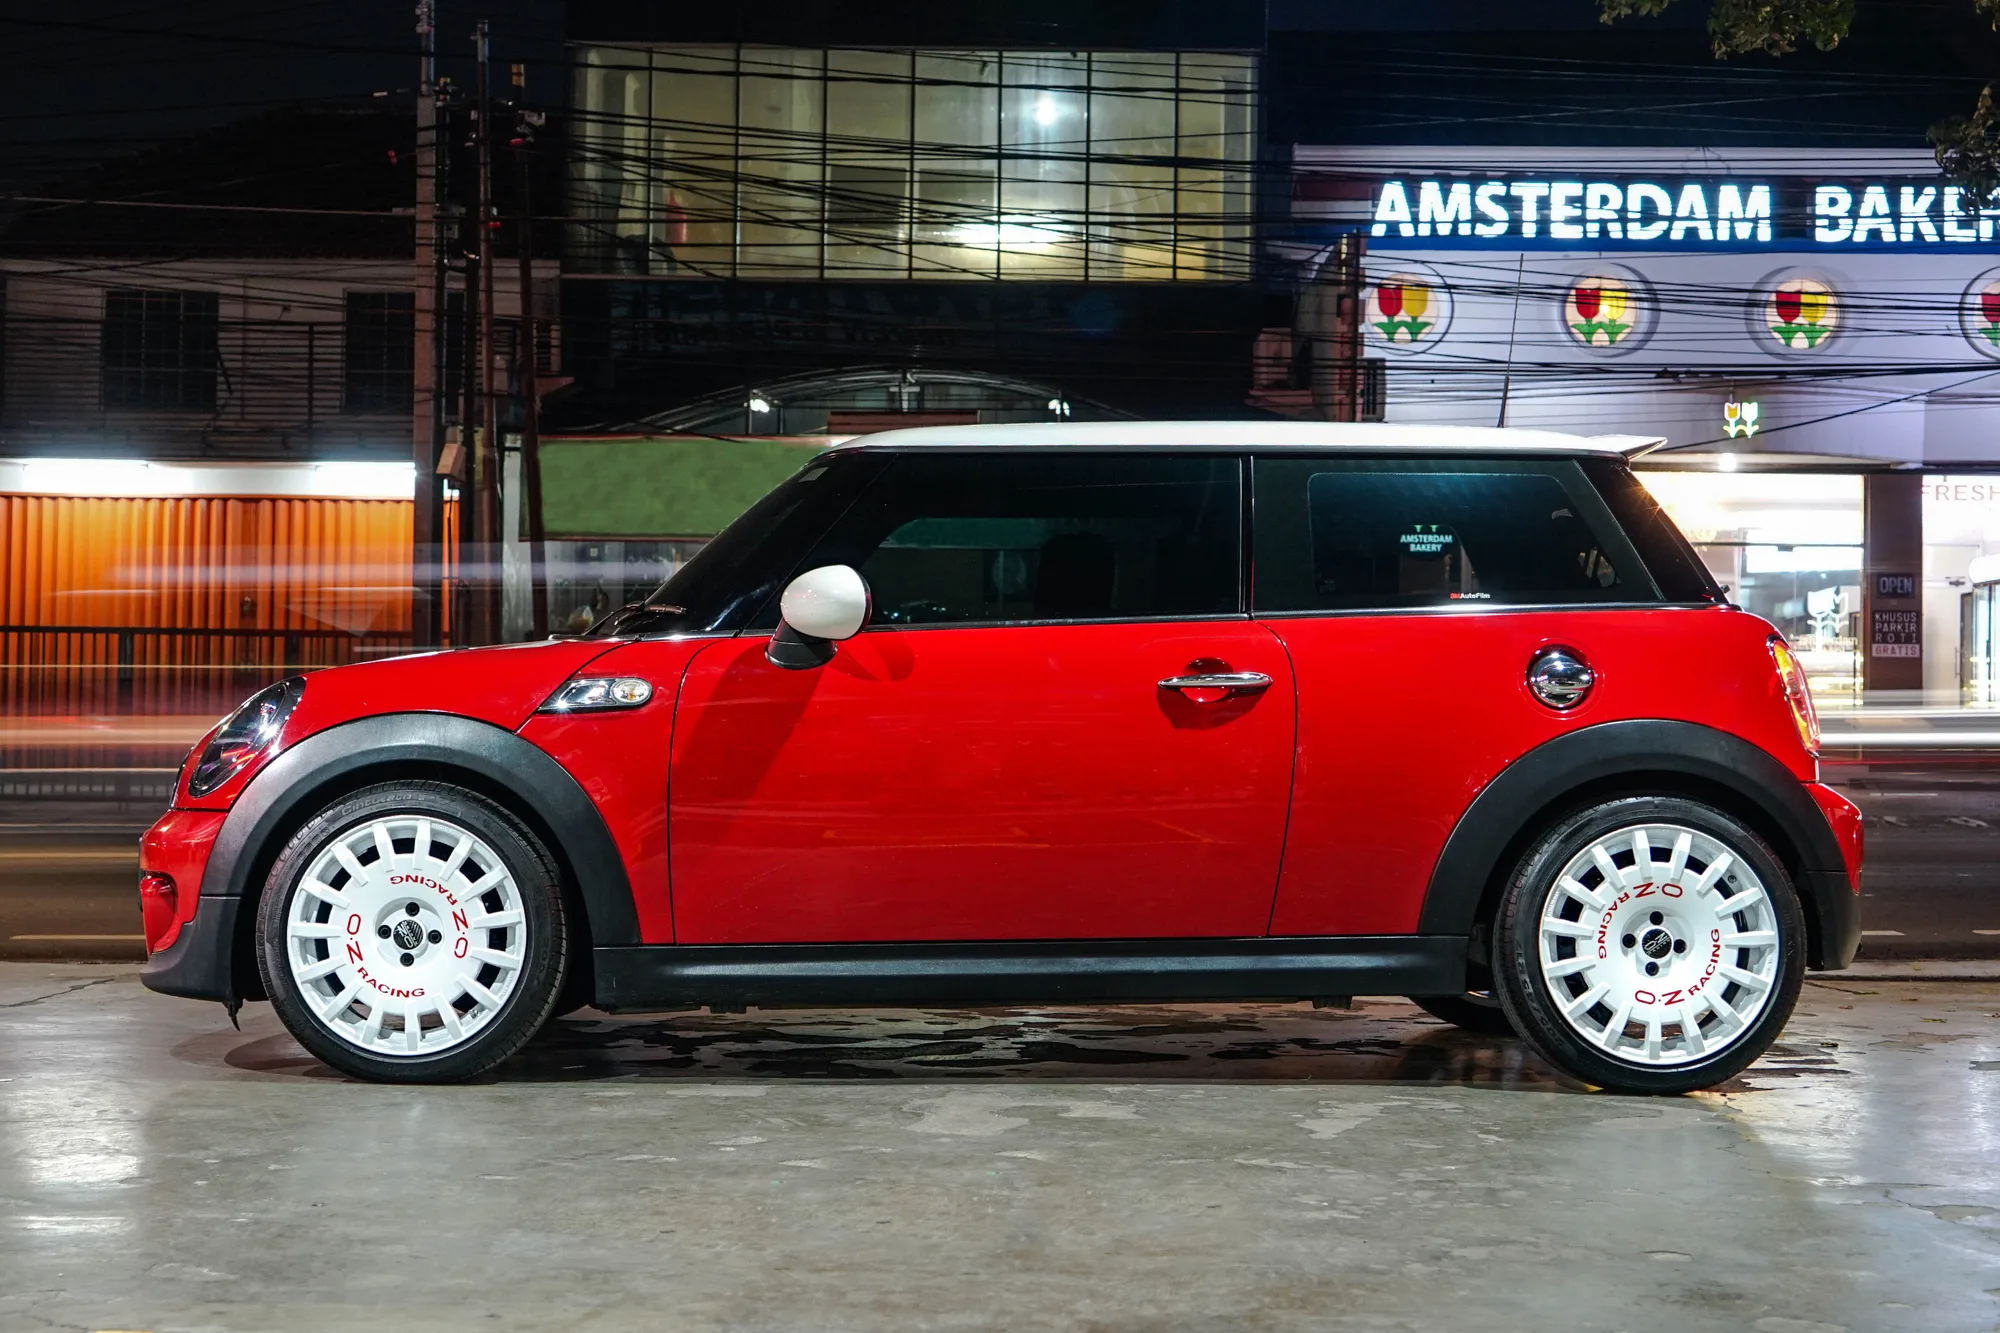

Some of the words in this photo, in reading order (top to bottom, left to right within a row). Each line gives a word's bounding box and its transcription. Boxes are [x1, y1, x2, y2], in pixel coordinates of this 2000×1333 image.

[1371, 181, 1772, 241] AMSTERDAM
[1400, 534, 1453, 543] AMSTERDAM
[1409, 543, 1442, 552] BAKERY
[1880, 577, 1912, 594] OPEN
[1875, 612, 1917, 622] KHUSUS
[1875, 623, 1917, 632] PARKIR
[1875, 645, 1917, 656] GRATIS
[390, 874, 458, 905] RACING
[1597, 892, 1631, 960] RACING
[1688, 928, 1720, 996] RACING
[357, 967, 425, 998] RACING
